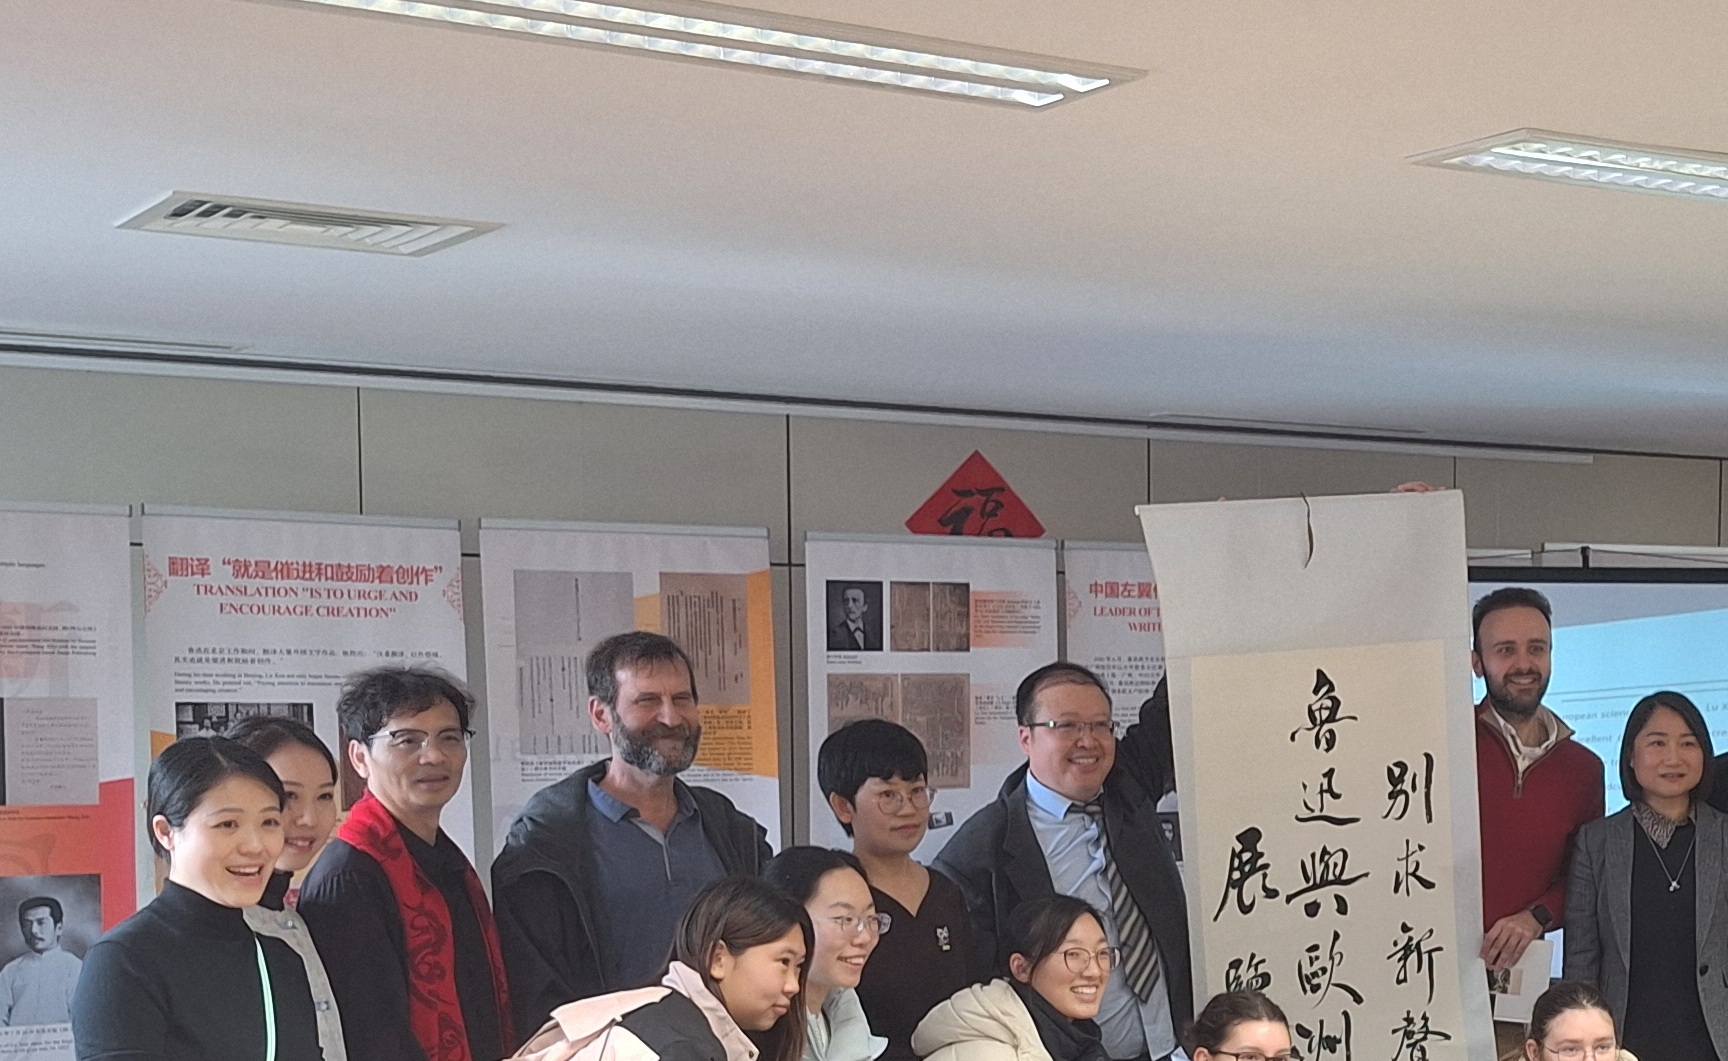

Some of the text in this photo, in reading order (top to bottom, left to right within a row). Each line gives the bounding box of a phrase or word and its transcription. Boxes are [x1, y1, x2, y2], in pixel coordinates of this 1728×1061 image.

[193, 583, 298, 598] TRANSLATION
[323, 588, 343, 600] TO
[347, 588, 386, 601] URGE
[389, 590, 419, 602] AND
[219, 602, 396, 619] ENCOURAGE CREATION"
[1093, 606, 1137, 617] LEADER
[1706, 703, 1718, 711] Lu
